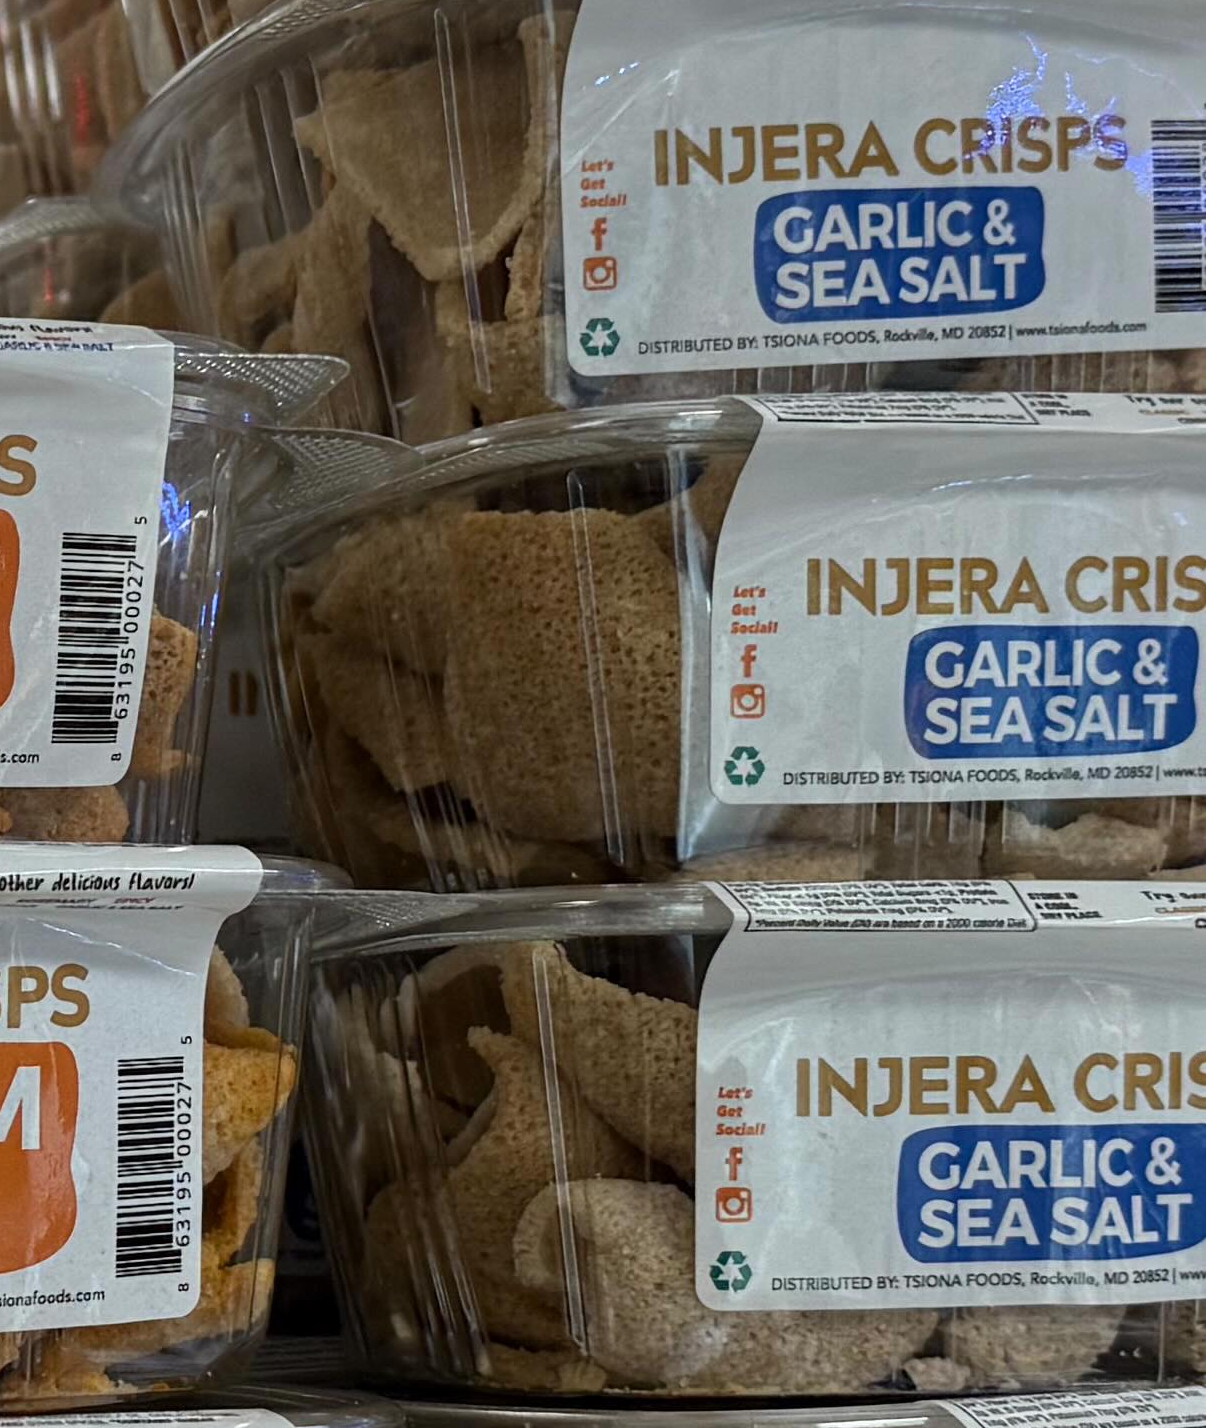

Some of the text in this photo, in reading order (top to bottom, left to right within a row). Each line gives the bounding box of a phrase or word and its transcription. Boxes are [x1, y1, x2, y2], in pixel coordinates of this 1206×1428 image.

[654, 113, 1128, 187] INJERA CRISPS
[580, 177, 606, 191] Get
[773, 198, 1017, 254] GARLIC &
[775, 252, 1027, 310] SEA SALT
[637, 337, 733, 356] DISTRIBUTED
[762, 333, 820, 349] TSIONA
[941, 327, 965, 340] MD
[967, 324, 1006, 339] 20852
[732, 584, 767, 599] Let's
[806, 555, 1050, 617] INJERA
[731, 603, 756, 617] Get
[924, 637, 1169, 689] GARLIC &
[924, 693, 1178, 745] SEA SALT
[782, 770, 879, 786] DISTRIBUTED
[882, 770, 905, 785] BY:
[909, 769, 964, 785] TSIONA
[967, 768, 1020, 783] FOODS,
[1087, 766, 1111, 780] MD
[52, 872, 121, 892] delicious
[128, 872, 195, 891] flavors!
[180, 1034, 193, 1045] 5
[717, 1085, 754, 1100] Let's
[795, 1053, 1057, 1118] INJERA
[716, 1104, 743, 1119] Get
[917, 1135, 1183, 1191] GARLIC &
[917, 1193, 1194, 1248] SEA SALT
[771, 1275, 873, 1292] DISTRIBUTED
[876, 1274, 900, 1290] BY:
[903, 1274, 963, 1289] TSIONA
[966, 1272, 1026, 1288] FOODS,
[1104, 1271, 1130, 1285] MD
[1133, 1269, 1170, 1284] 20852
